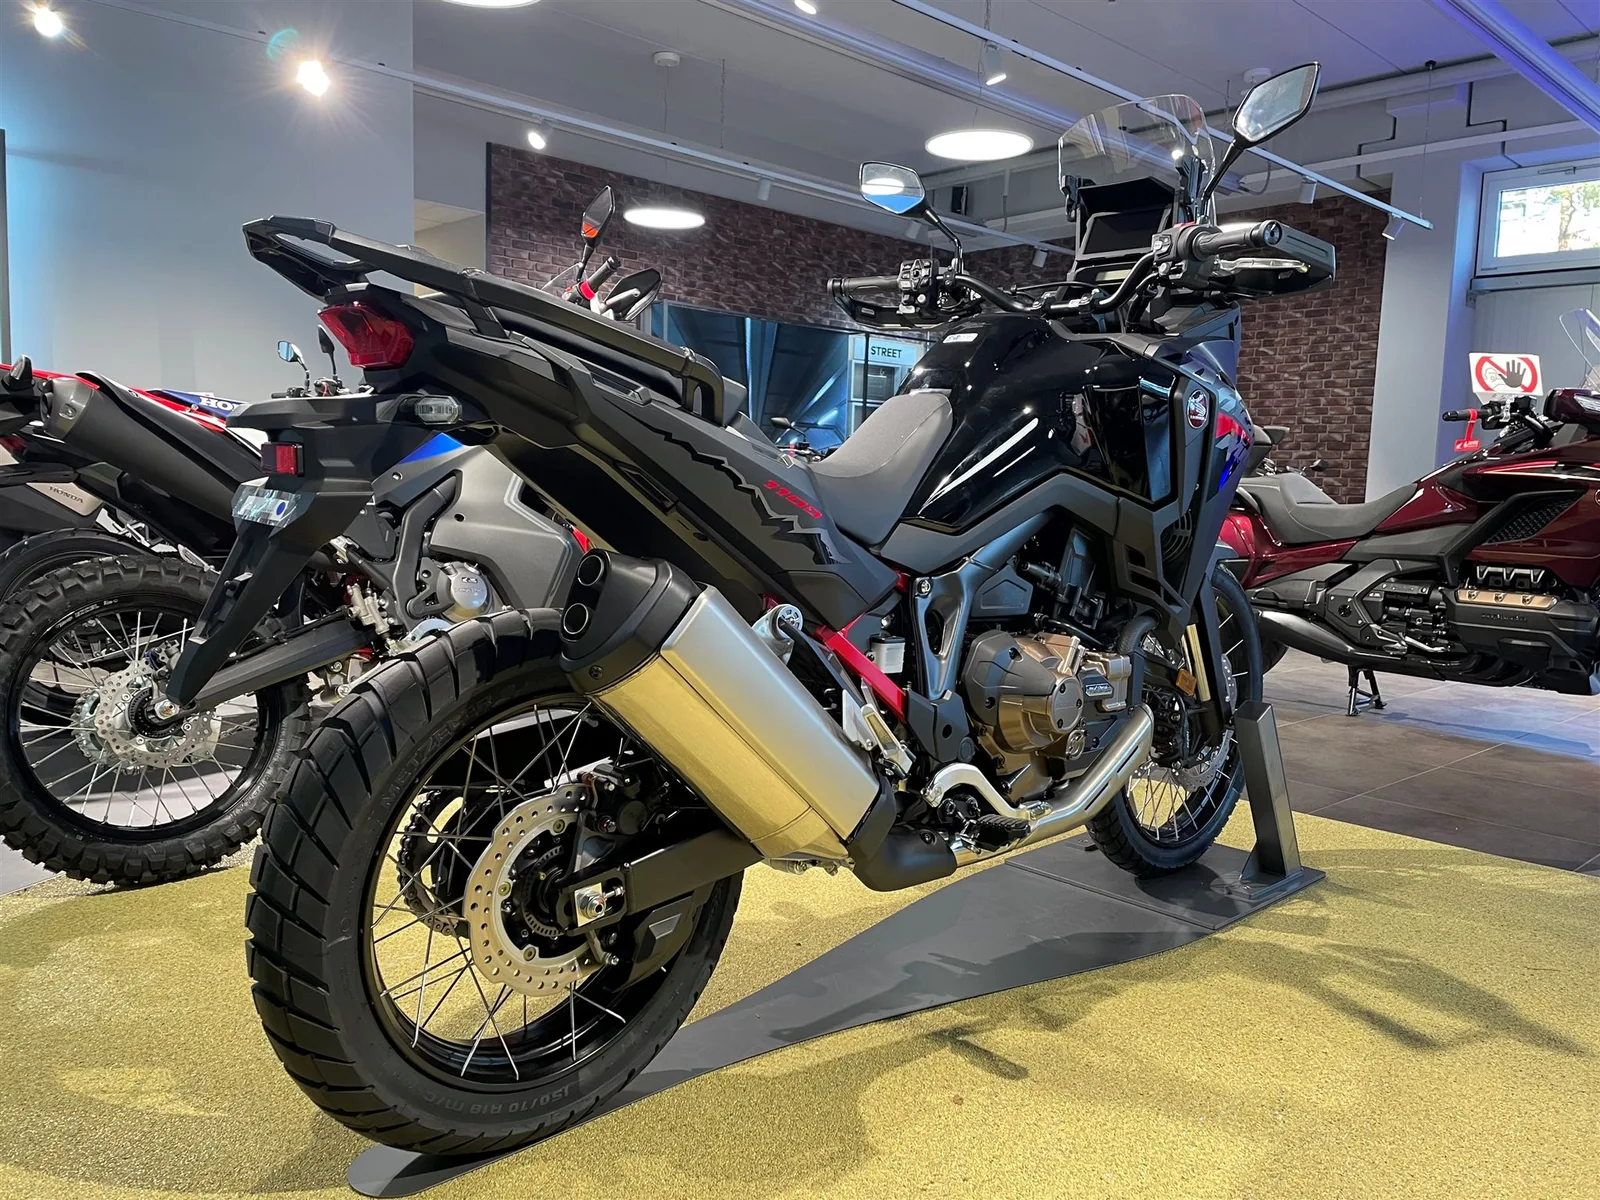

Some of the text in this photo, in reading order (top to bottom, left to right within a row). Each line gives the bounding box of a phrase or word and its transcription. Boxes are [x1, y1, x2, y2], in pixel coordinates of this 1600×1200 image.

[870, 346, 902, 359] STREET
[49, 486, 84, 503] HONDA
[763, 479, 823, 519] 1100
[470, 1103, 503, 1115] R18
